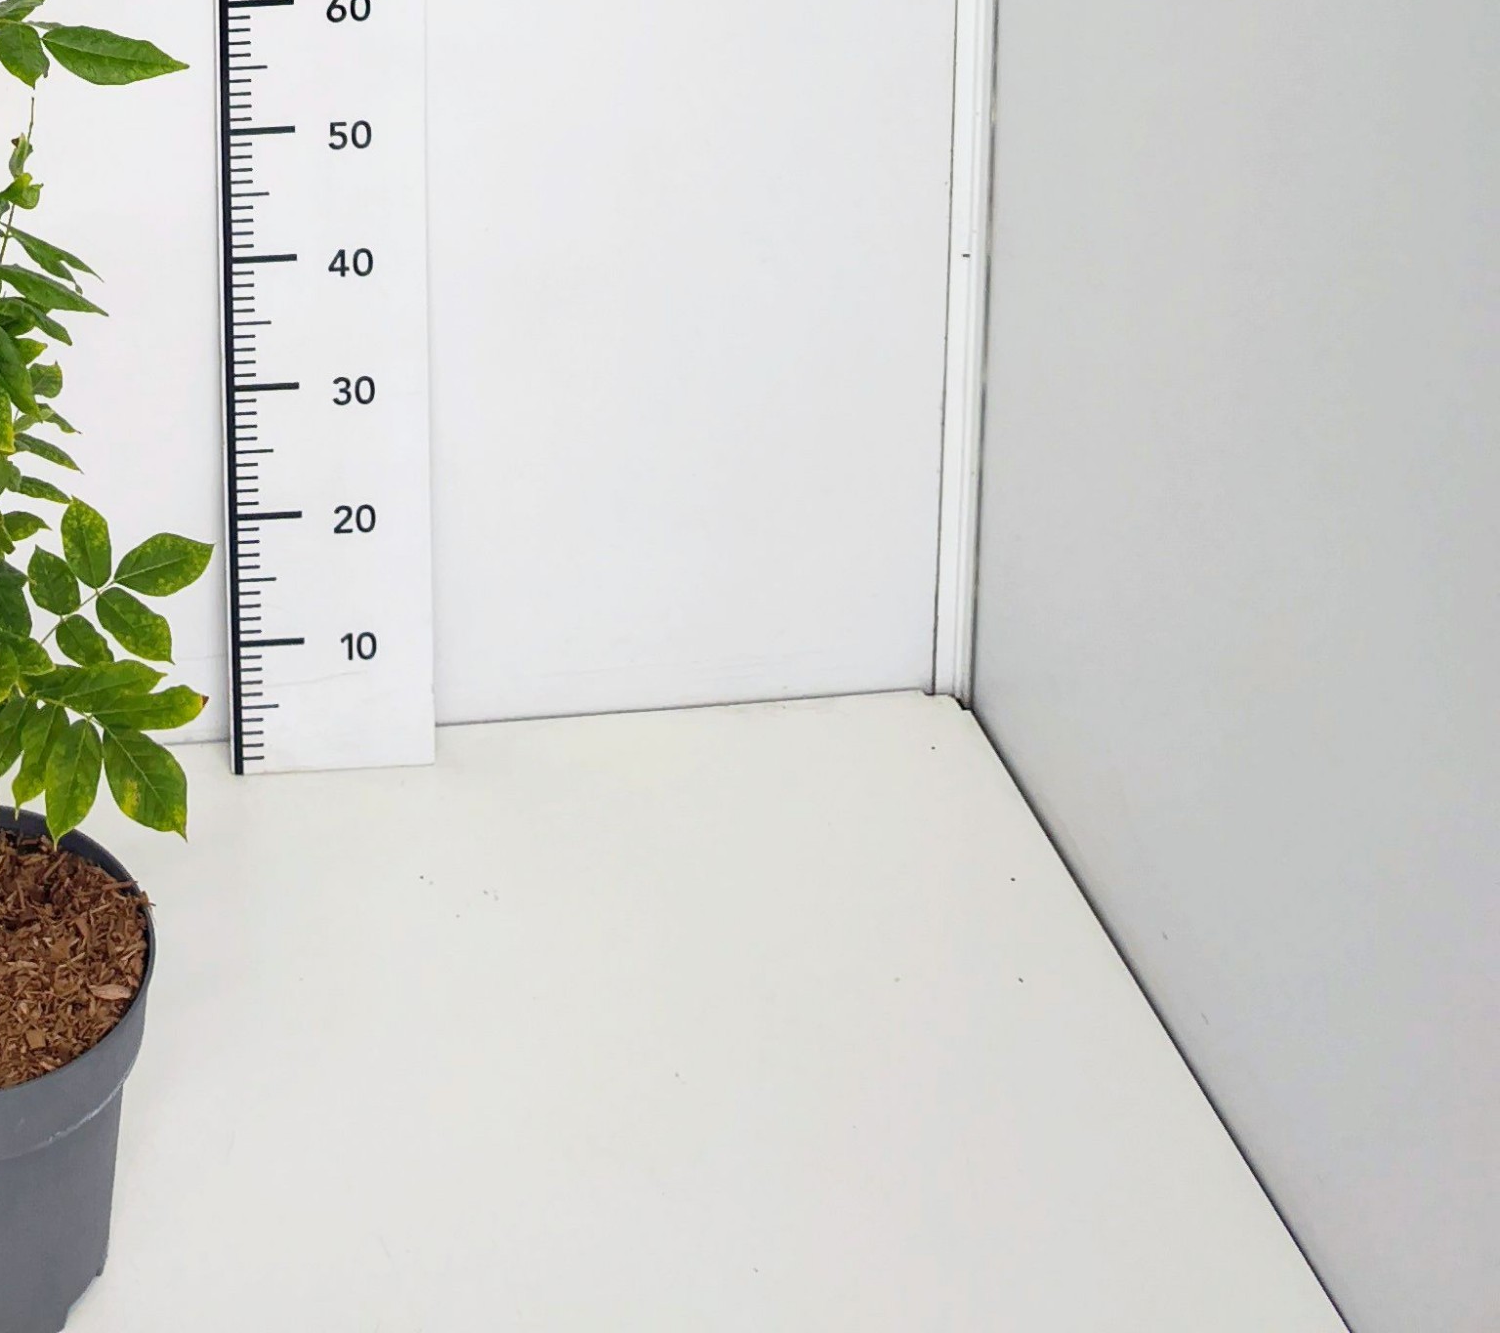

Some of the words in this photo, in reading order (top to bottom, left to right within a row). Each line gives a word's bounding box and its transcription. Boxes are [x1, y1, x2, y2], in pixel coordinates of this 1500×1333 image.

[328, 120, 372, 150] 50
[328, 248, 374, 278] 40
[332, 375, 376, 406] 30
[333, 504, 376, 534] 20
[340, 631, 377, 661] 10
